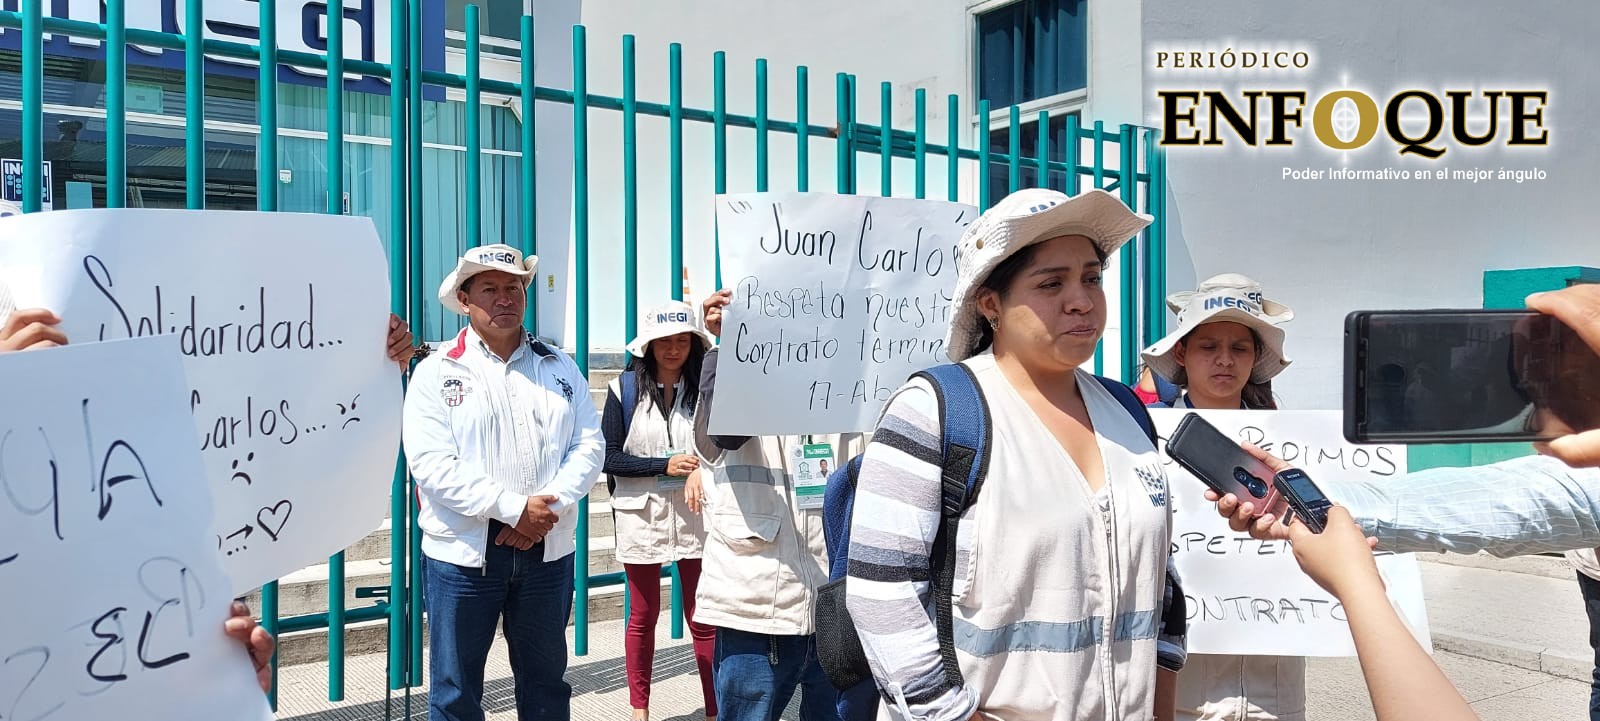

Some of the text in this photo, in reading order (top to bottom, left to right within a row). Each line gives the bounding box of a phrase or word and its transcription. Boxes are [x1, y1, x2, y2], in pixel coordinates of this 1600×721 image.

[479, 252, 516, 265] INEGI
[657, 312, 687, 323] INEGI
[865, 293, 951, 332] nuestr
[736, 323, 944, 374] Contrato termin
[1185, 594, 1347, 624] ONTRATO
